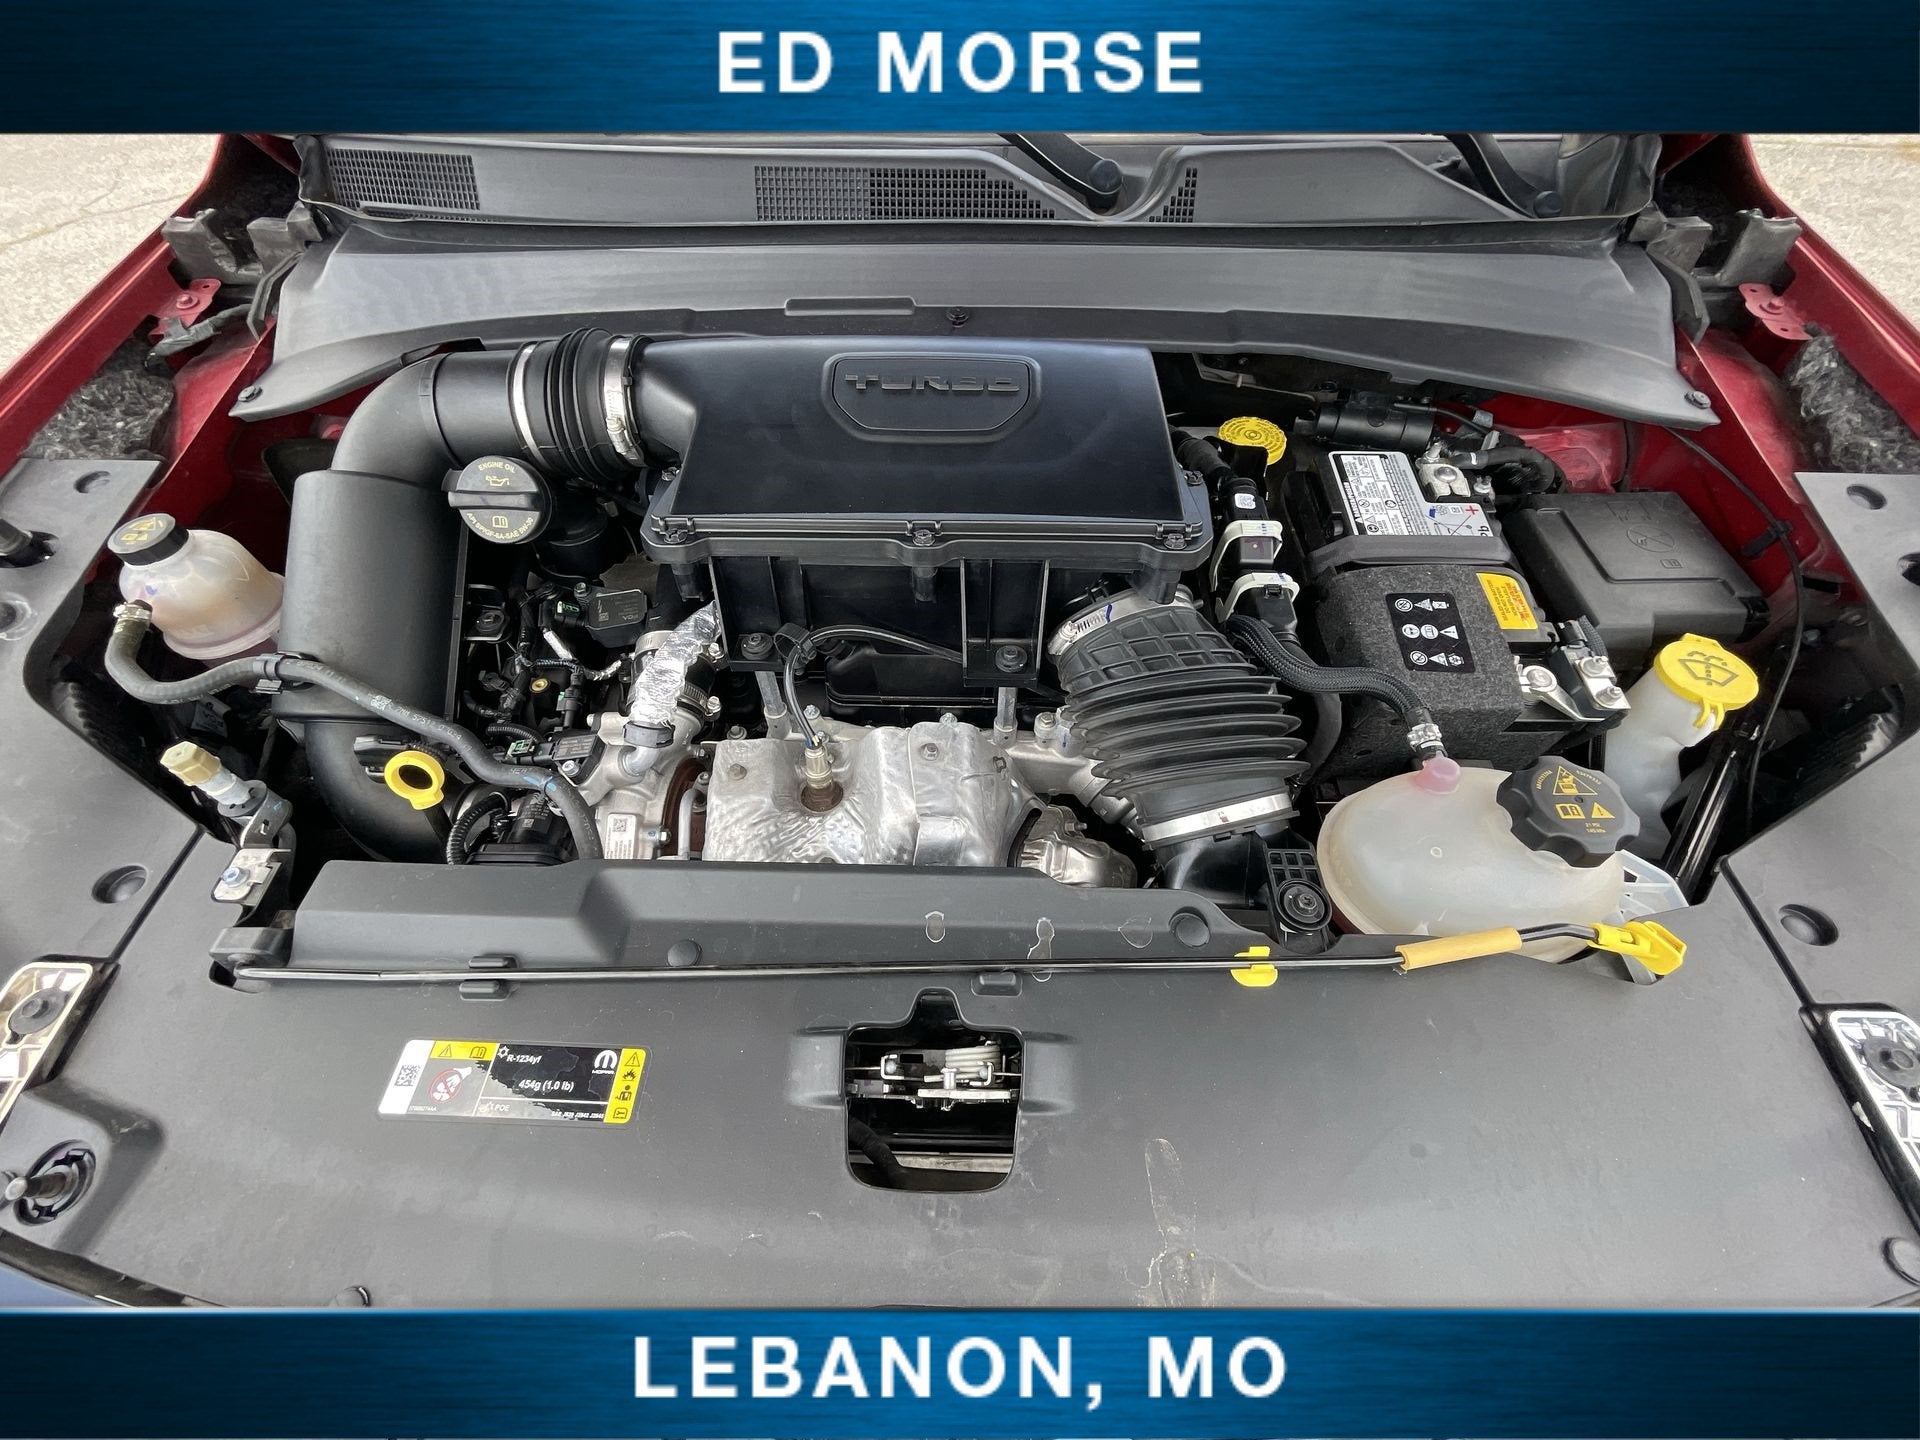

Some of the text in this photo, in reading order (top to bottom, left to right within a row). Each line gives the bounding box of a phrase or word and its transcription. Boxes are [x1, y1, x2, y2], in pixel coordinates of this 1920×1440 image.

[478, 461, 515, 474] ENGINE OIL
[466, 512, 477, 524] API
[506, 1054, 542, 1065] R-1234yf
[518, 1079, 574, 1092] 454g (1.0 lb)
[495, 1104, 510, 1112] POE
